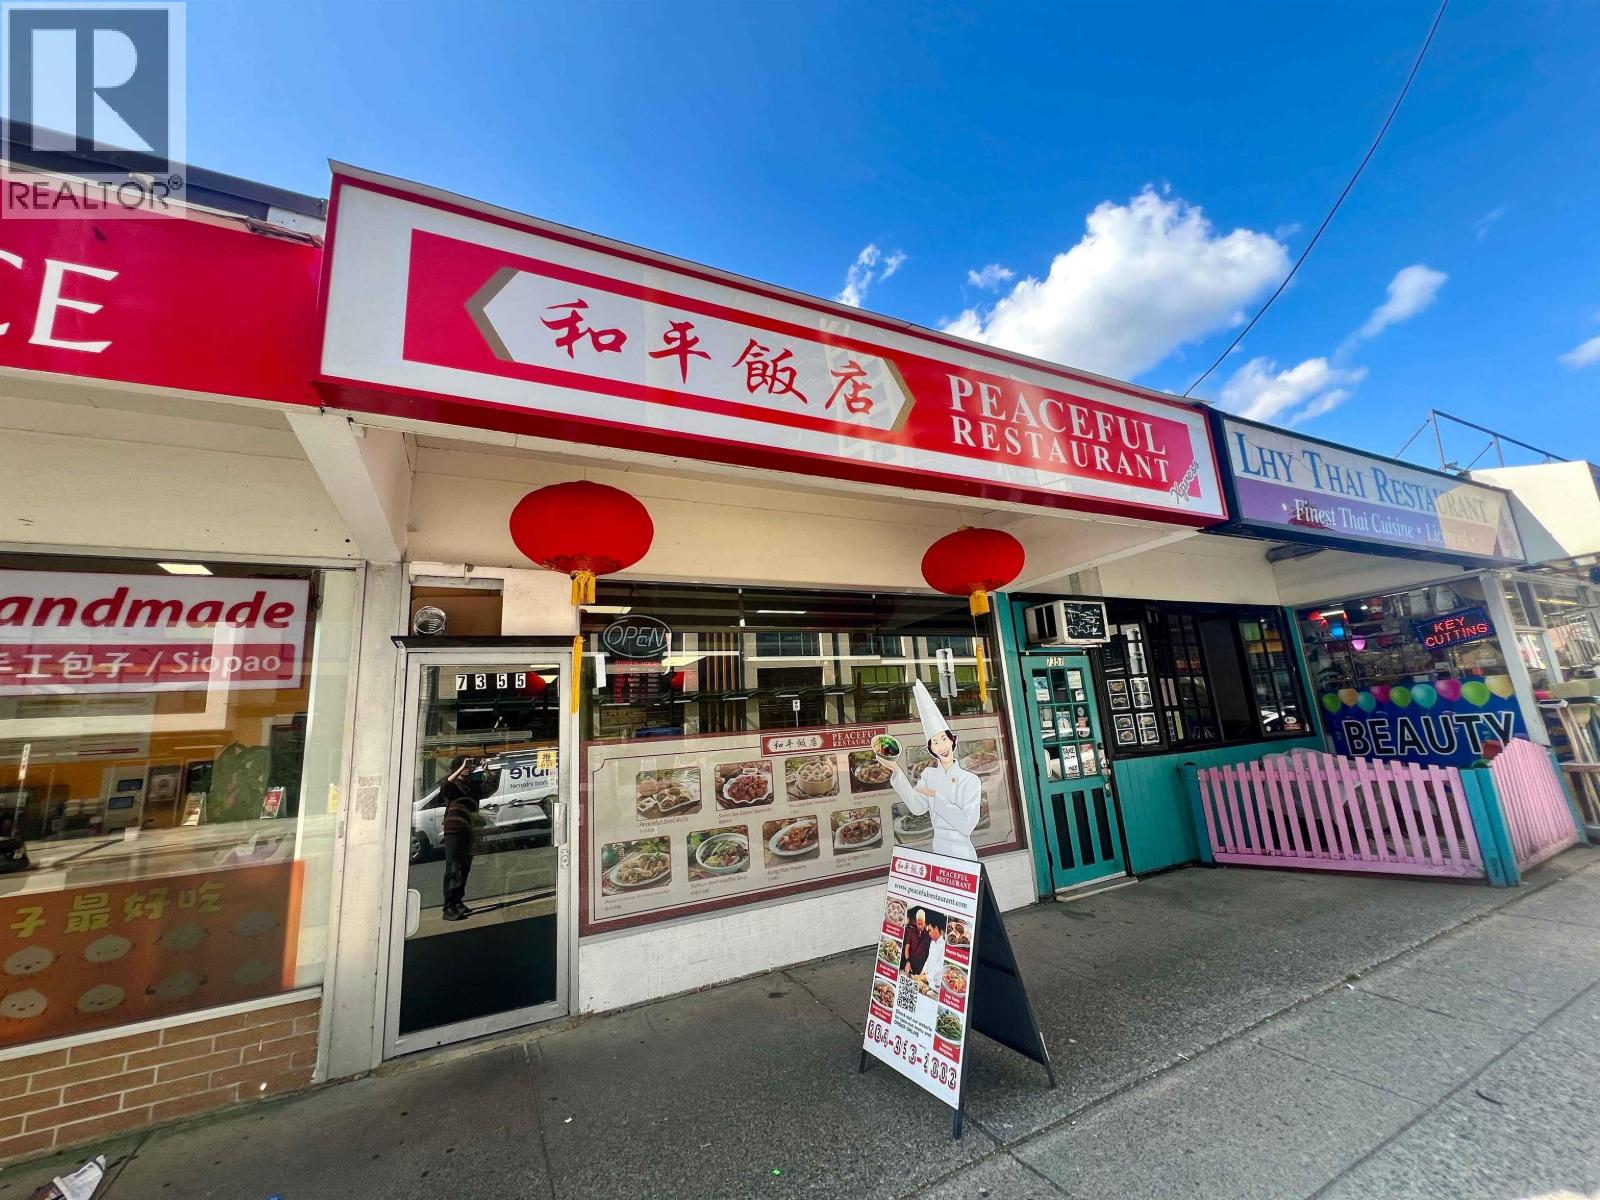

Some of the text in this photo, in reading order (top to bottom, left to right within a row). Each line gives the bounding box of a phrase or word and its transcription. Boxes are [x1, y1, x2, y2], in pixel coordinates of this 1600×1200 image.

[539, 298, 875, 415] 和平飯店
[945, 373, 1166, 455] PEACEFUL
[950, 415, 1169, 483] RESTAURANT
[1170, 460, 1199, 504] Xpress
[1294, 499, 1336, 526] Finest
[1338, 506, 1369, 531] Thai
[1371, 512, 1414, 539] Cuisine
[0, 587, 295, 629] andmade
[608, 625, 666, 648] OPEN
[1425, 623, 1488, 647] CUTTING
[1434, 616, 1465, 632] KEY
[172, 651, 281, 678] Siopao
[832, 730, 878, 741] PEACEFUL
[832, 738, 873, 748] RESTAURA
[1342, 712, 1514, 757] BEAUTY
[936, 875, 972, 890] RESTAURANT
[939, 869, 969, 882] PEACEFUL
